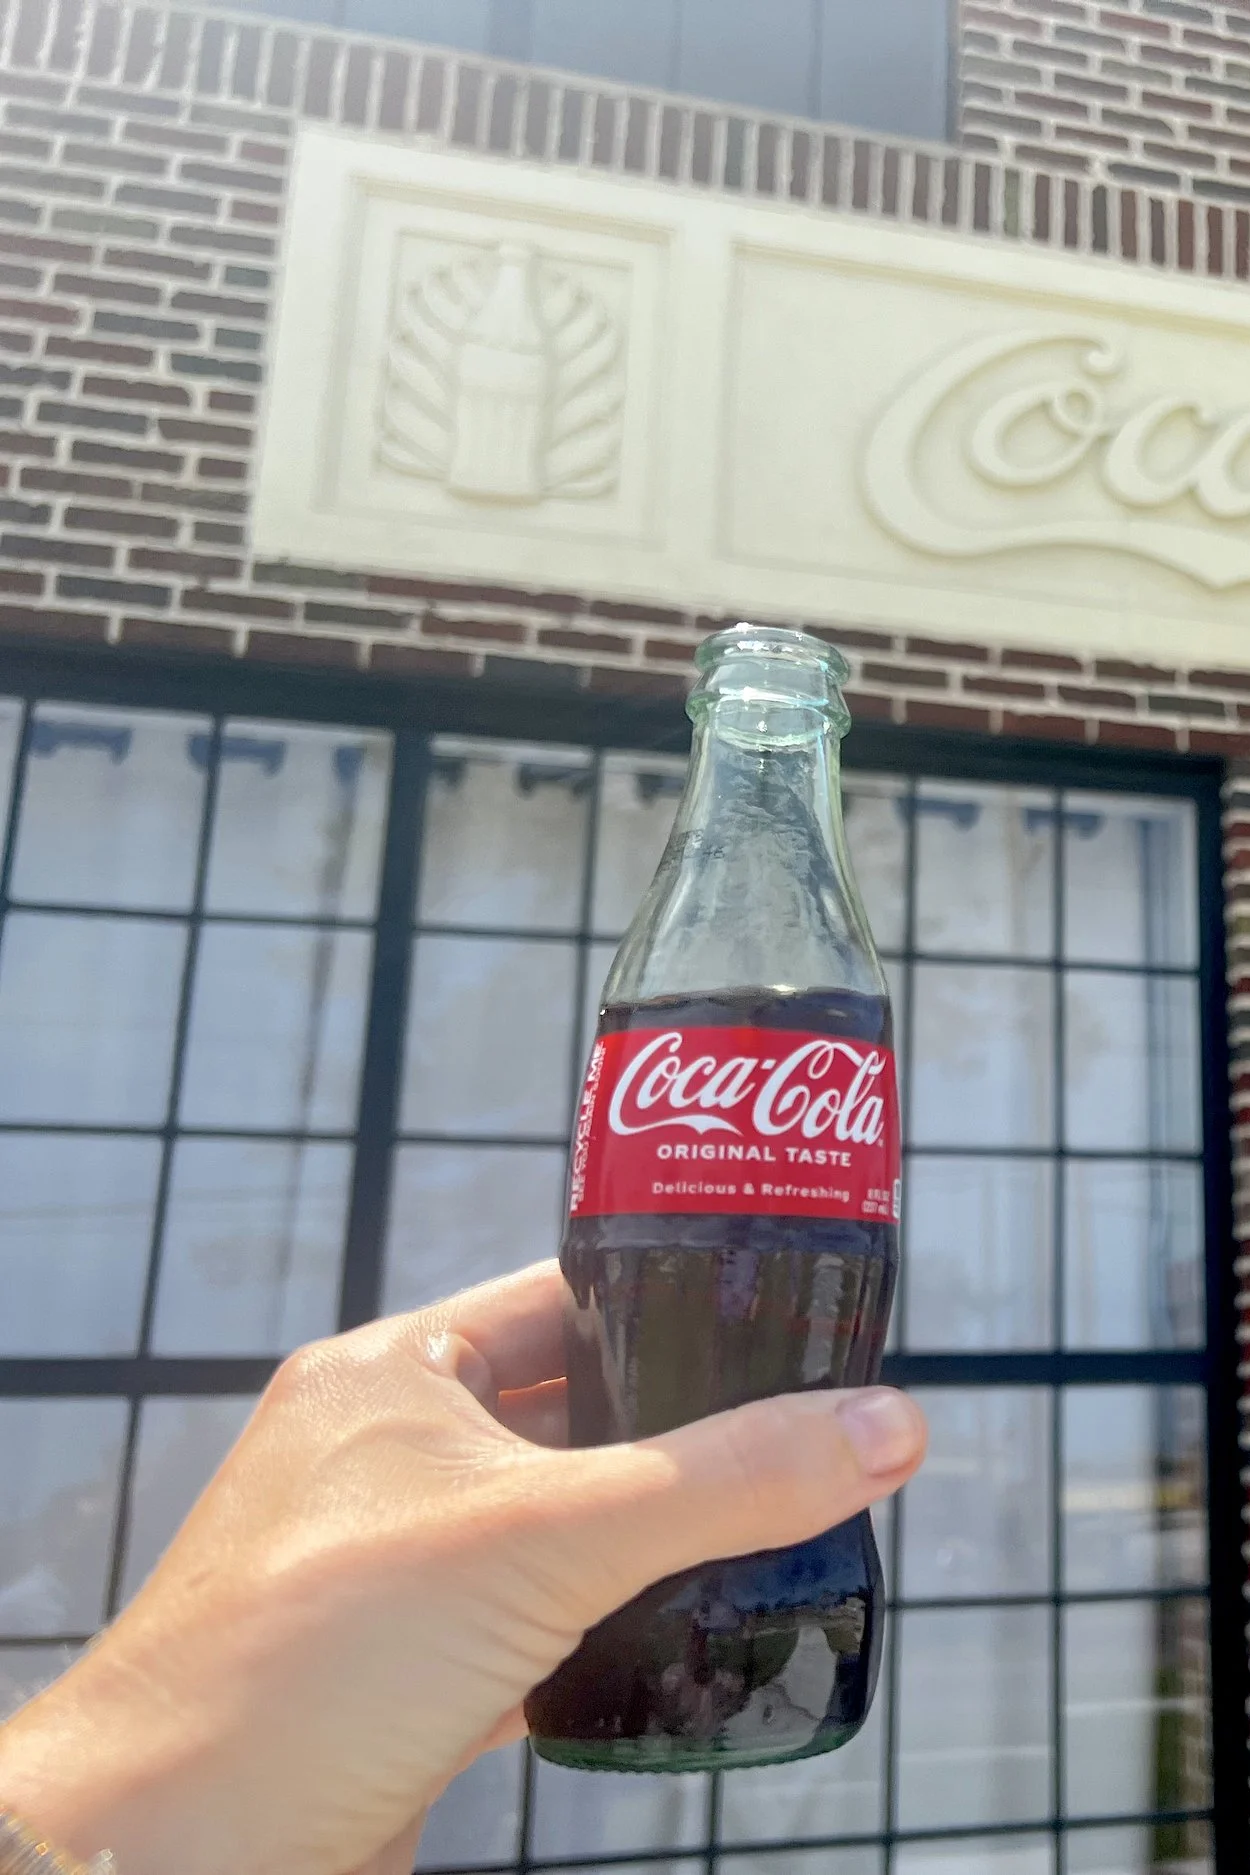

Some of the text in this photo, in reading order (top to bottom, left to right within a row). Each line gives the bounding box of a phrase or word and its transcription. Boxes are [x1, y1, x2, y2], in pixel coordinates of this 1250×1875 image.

[608, 1032, 886, 1145] Coca-Cola
[656, 1144, 852, 1167] ORIGINAL TASTE
[652, 1181, 736, 1196] Delicious
[742, 1182, 755, 1196] &
[760, 1183, 850, 1204] Refreshing
